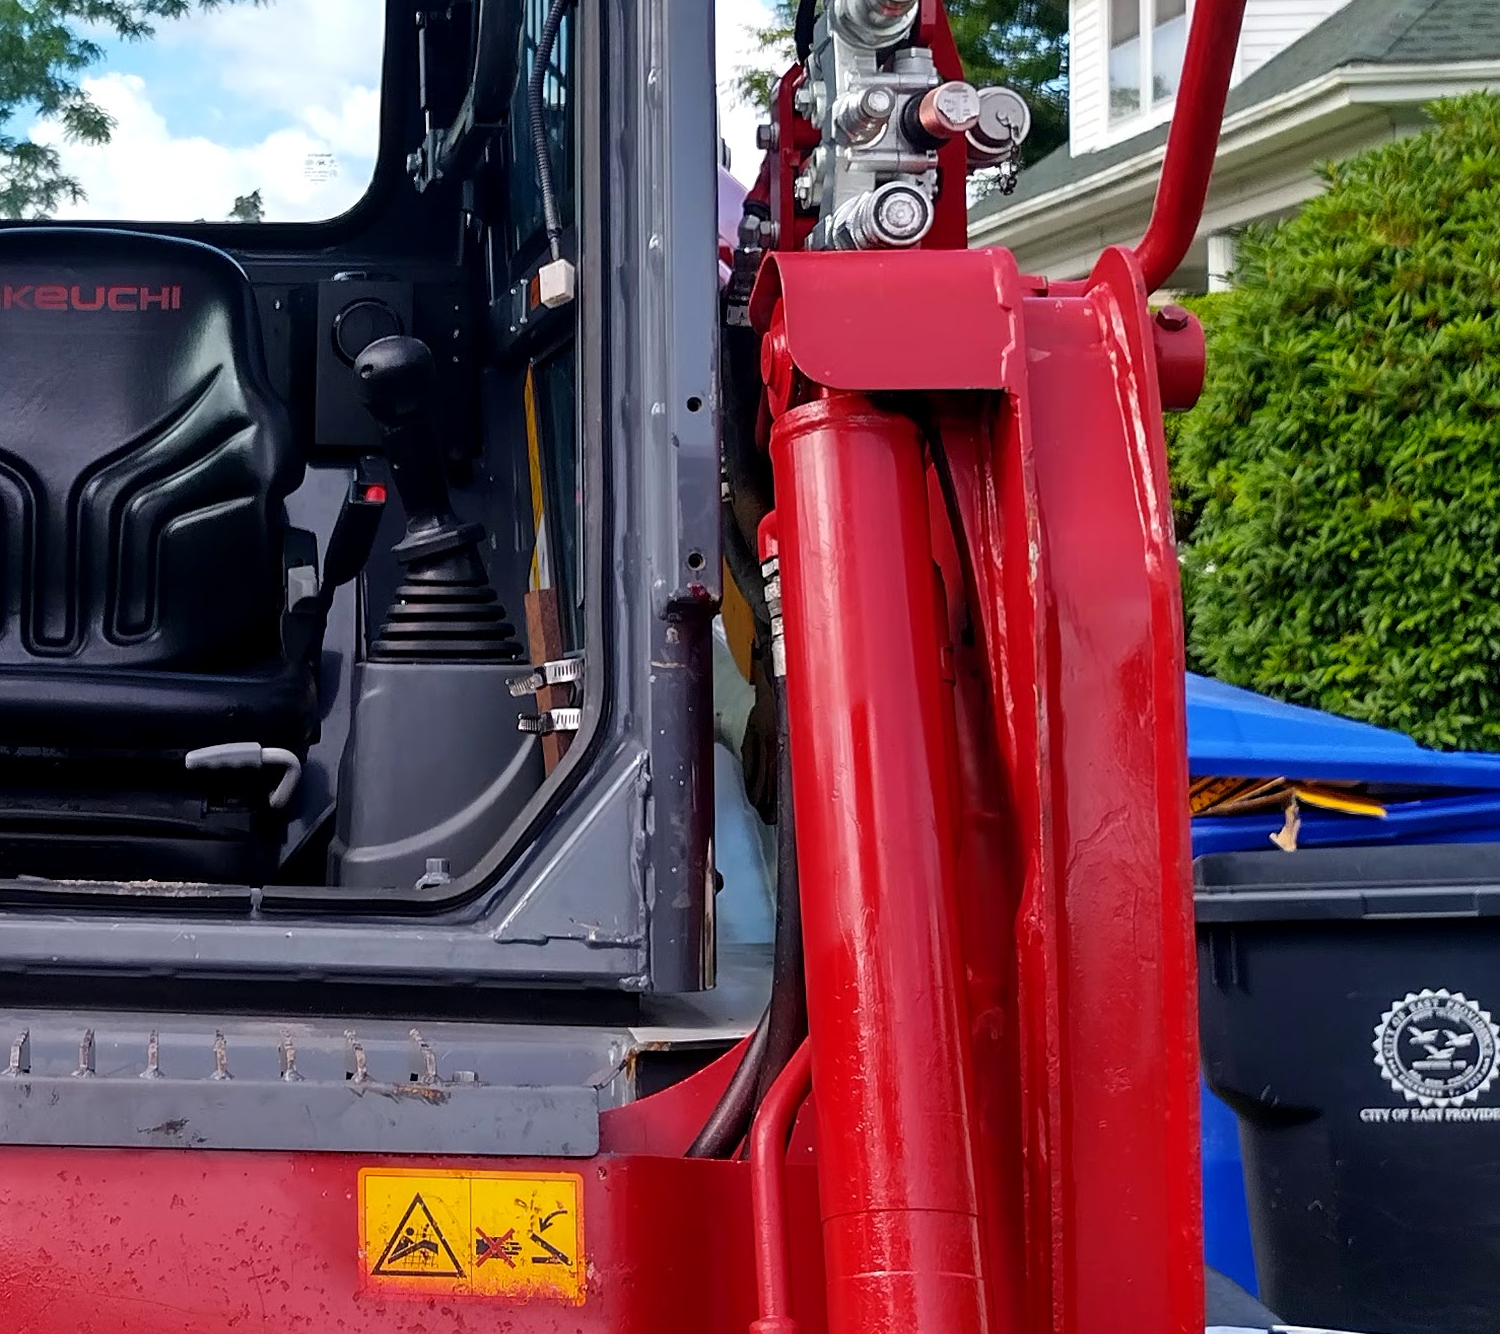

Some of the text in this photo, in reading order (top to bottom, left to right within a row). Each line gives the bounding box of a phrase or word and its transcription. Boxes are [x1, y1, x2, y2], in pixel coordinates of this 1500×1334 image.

[1359, 1108, 1391, 1123] CITY
[1392, 1108, 1410, 1123] OF
[1411, 1108, 1444, 1123] EAST
